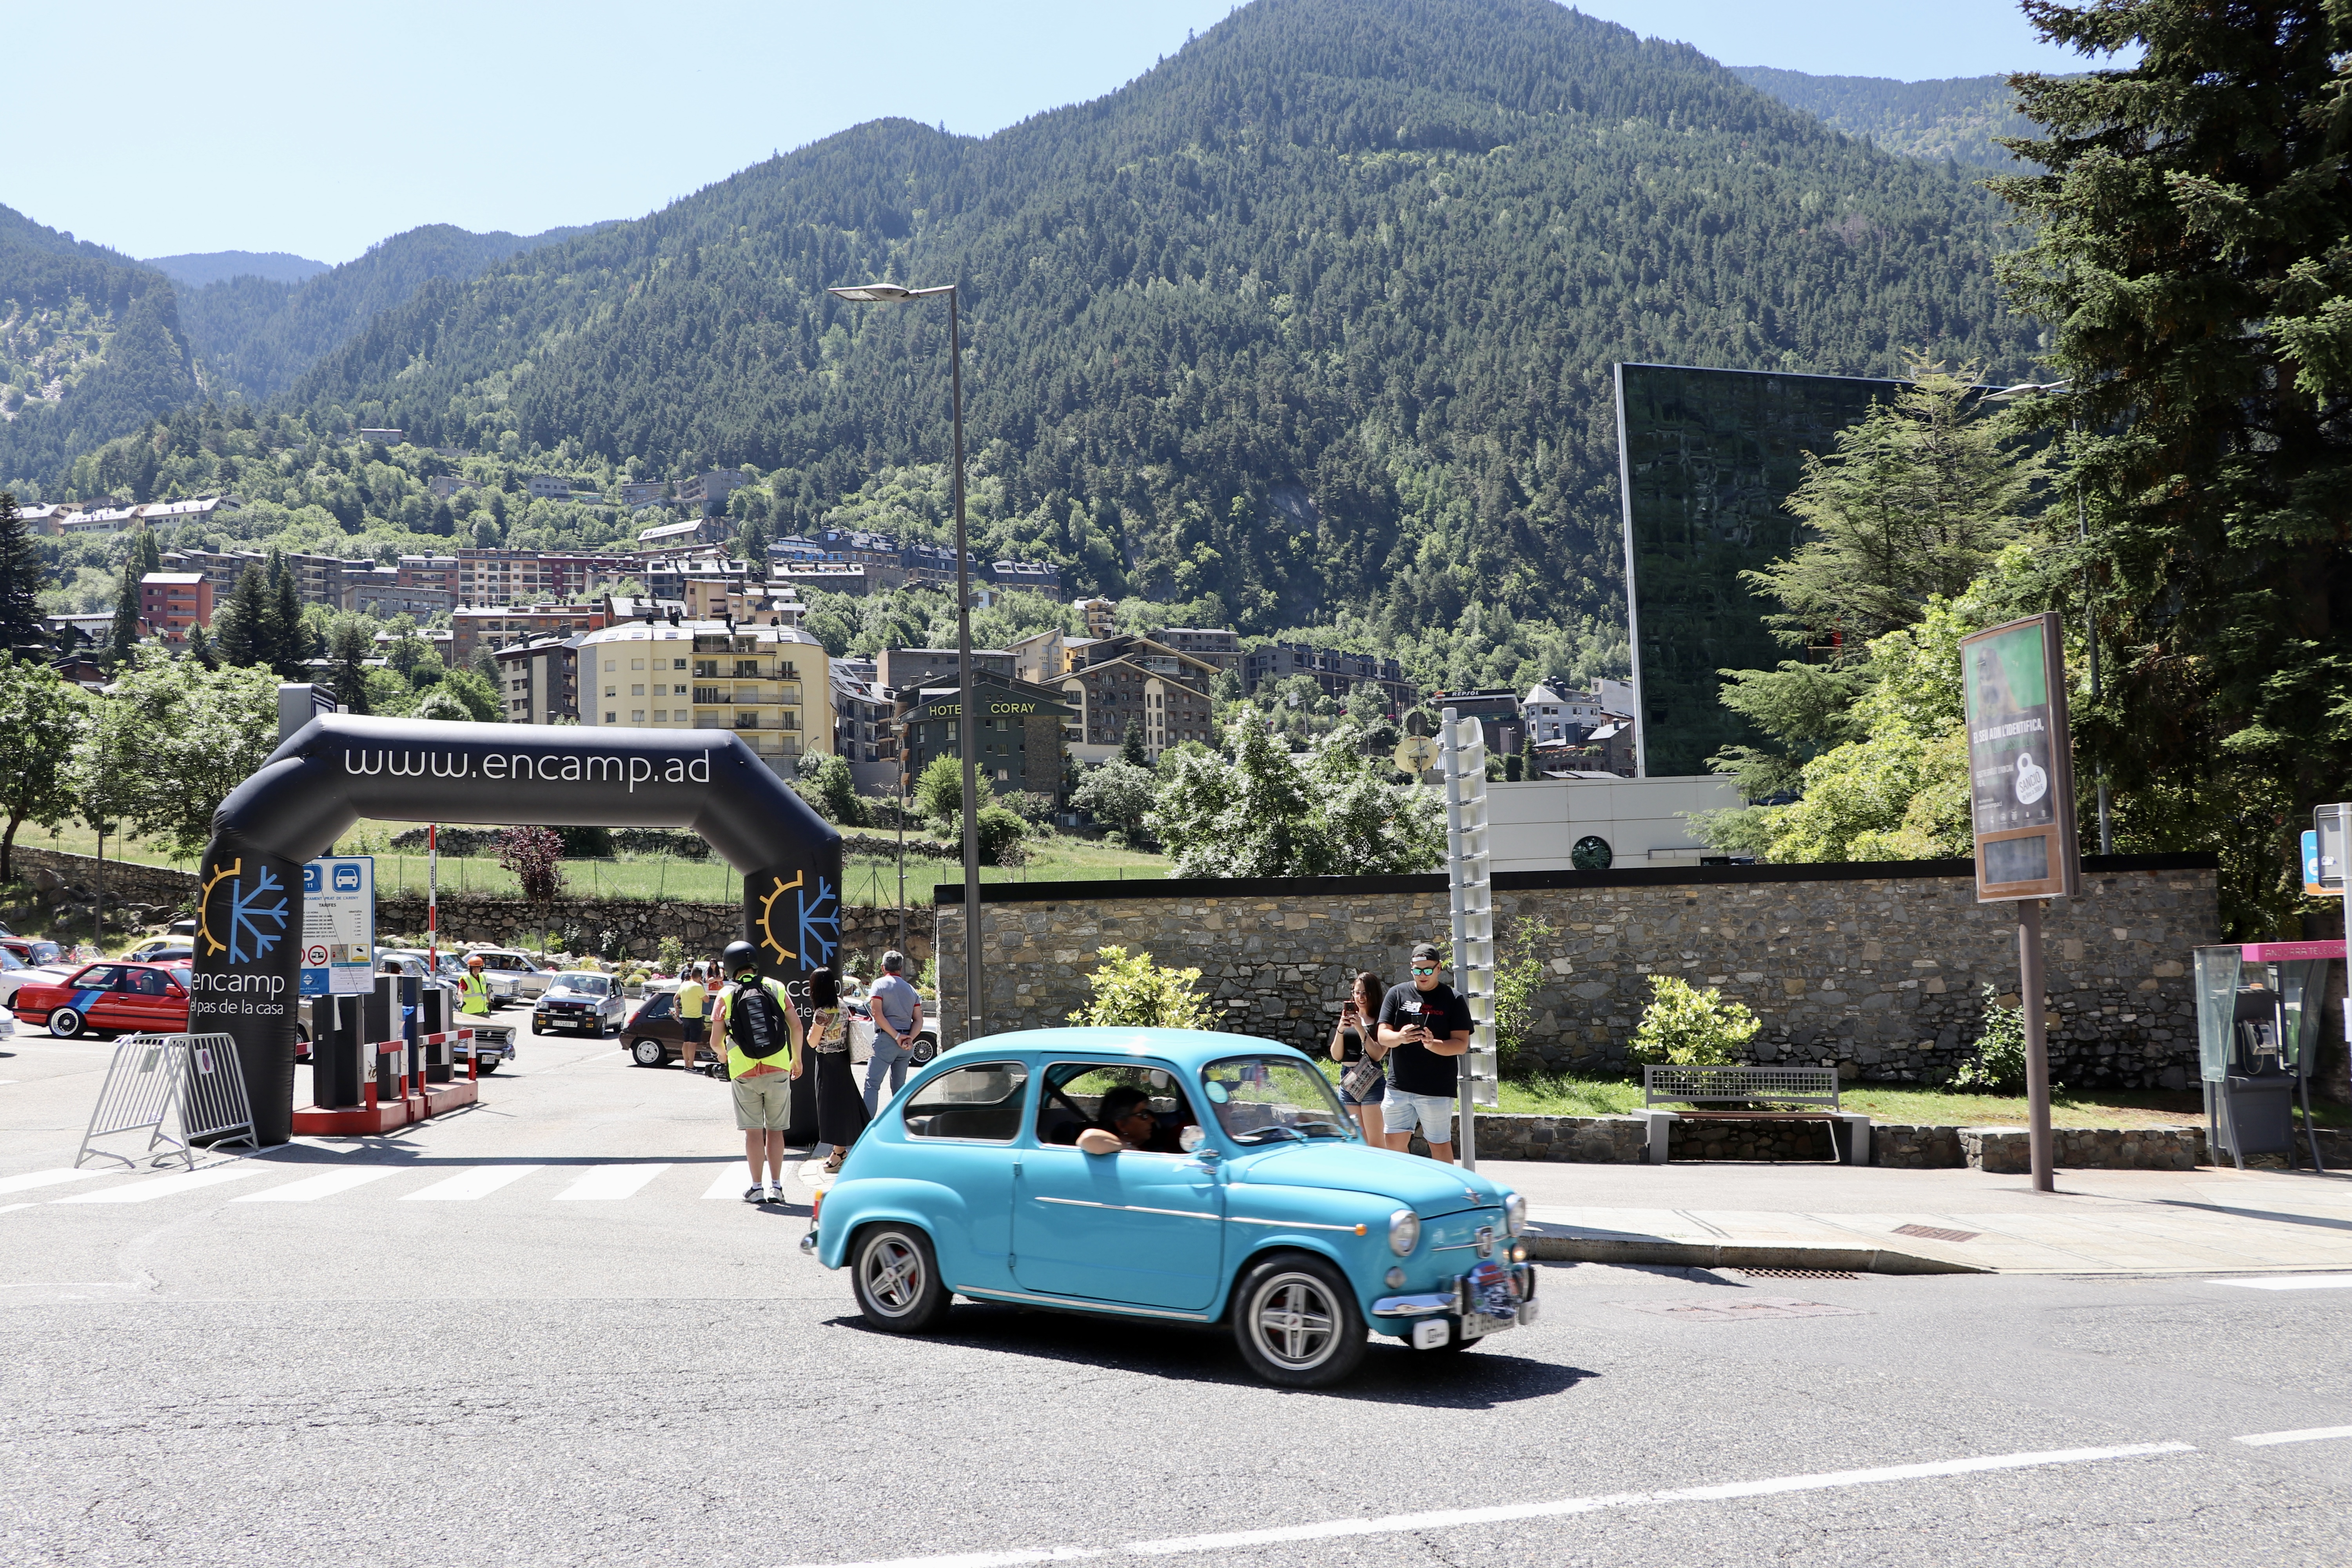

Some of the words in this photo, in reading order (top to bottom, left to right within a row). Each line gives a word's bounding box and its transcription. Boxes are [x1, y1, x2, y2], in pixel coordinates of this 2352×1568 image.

[929, 704, 961, 716] HOTE
[991, 703, 1036, 713] CORAY
[1973, 732, 1979, 744] EL
[1979, 728, 1989, 742] SEU
[1989, 726, 2002, 740] ADN
[345, 749, 709, 793] www.encamp.ad
[2019, 769, 2041, 793] SANCIÓ
[2265, 947, 2307, 957] ANDORRA
[192, 973, 285, 1001] encamp
[191, 997, 197, 1011] el
[198, 1002, 216, 1017] pas
[219, 998, 238, 1014] de
[241, 999, 253, 1014] la
[256, 1004, 283, 1014] casa
[746, 996, 770, 1047] PUMA
